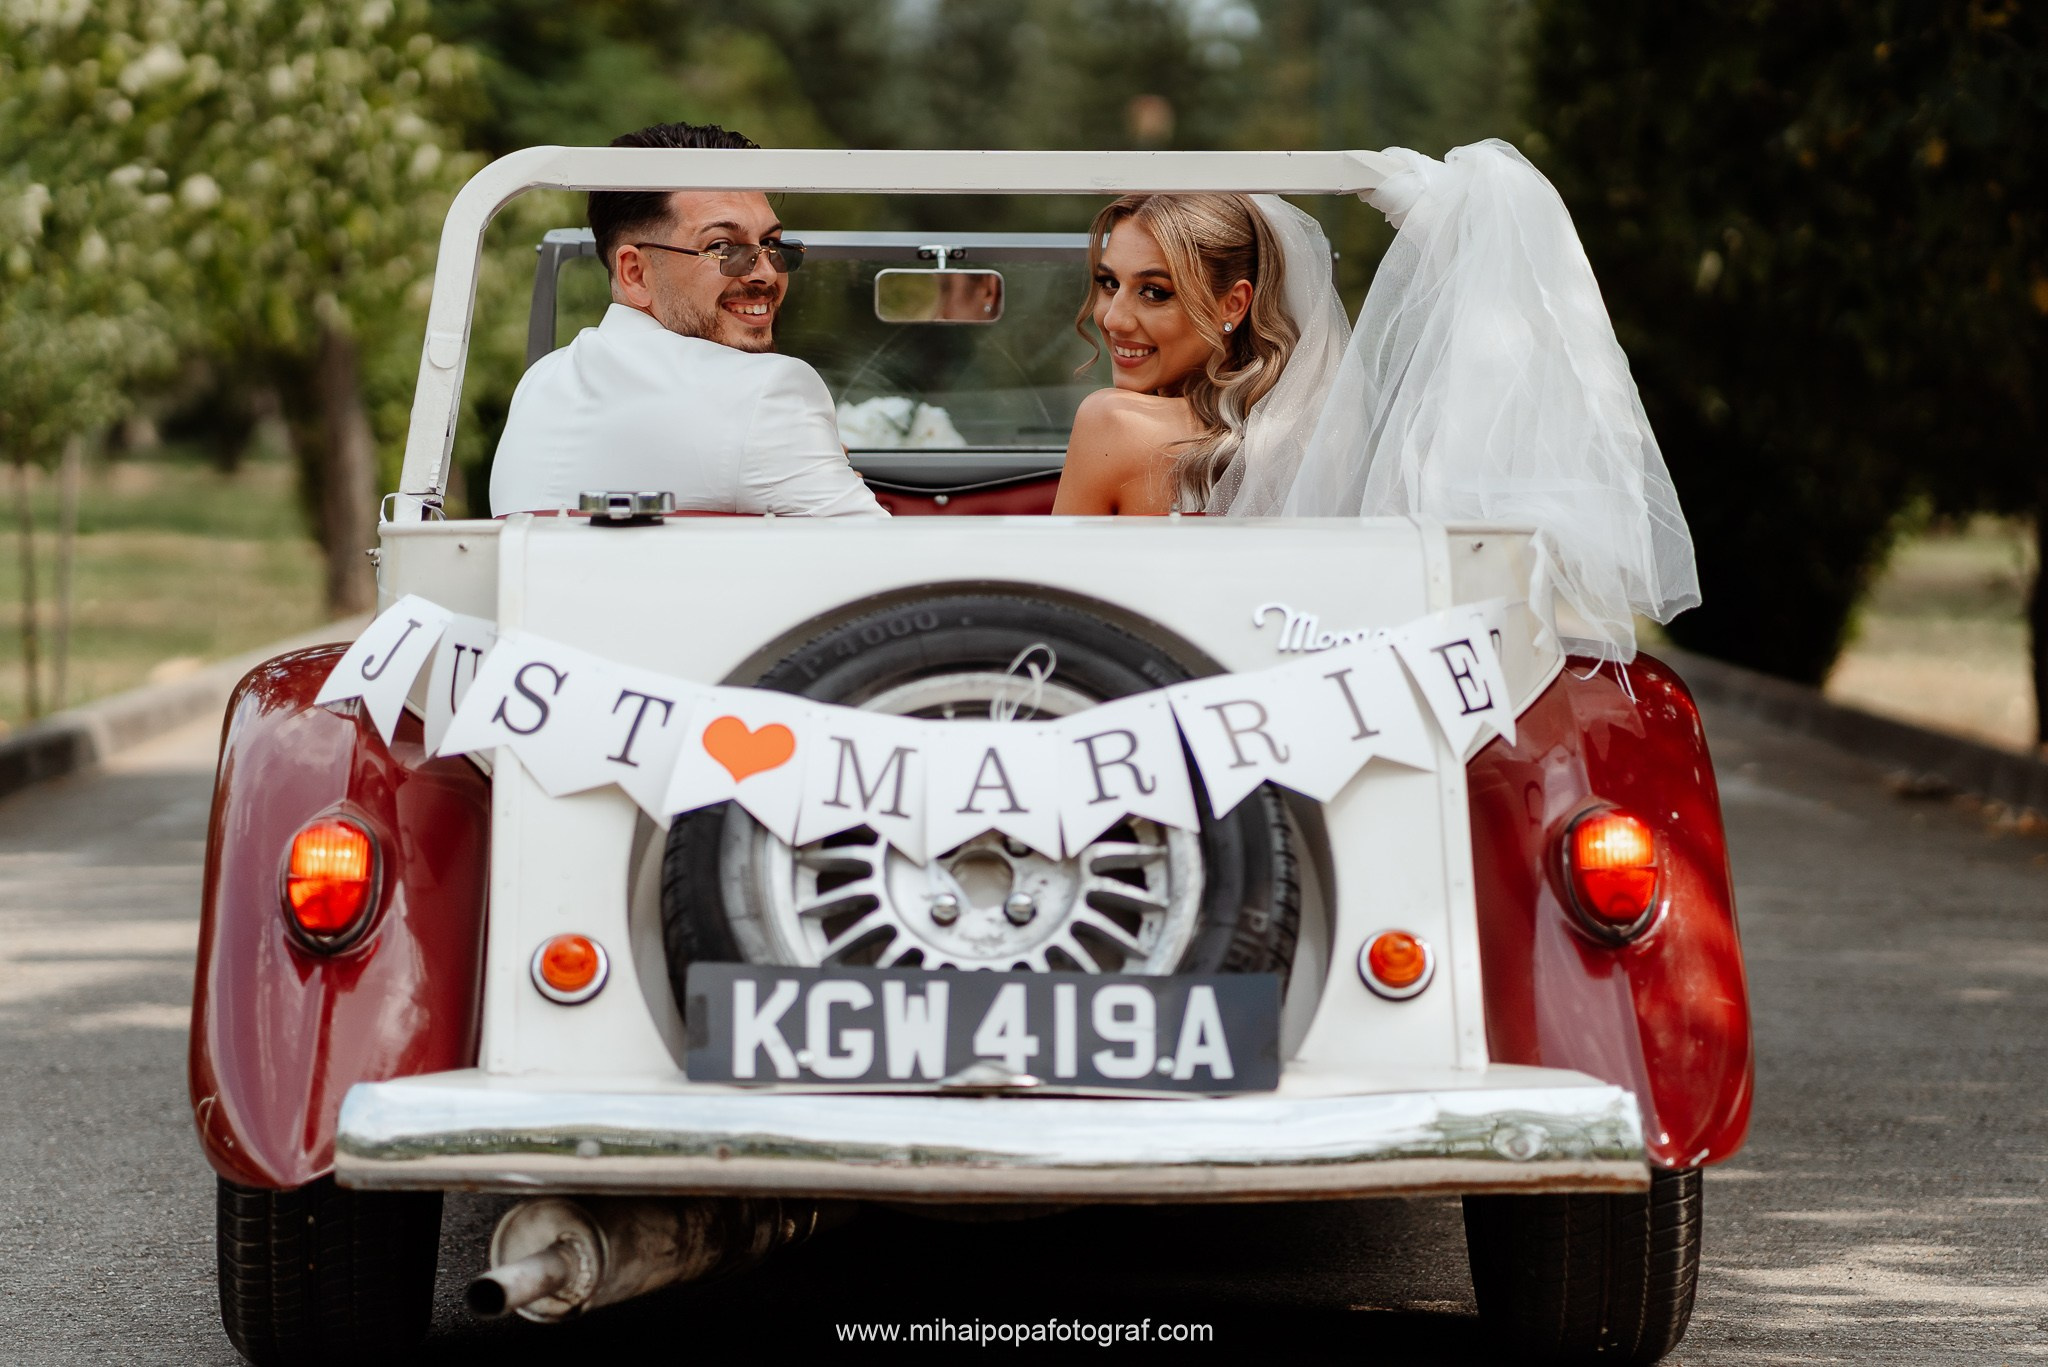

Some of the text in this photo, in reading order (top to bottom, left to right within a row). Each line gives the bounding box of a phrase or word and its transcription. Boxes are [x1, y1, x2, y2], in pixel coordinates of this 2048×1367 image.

[833, 609, 940, 657] 4000
[820, 627, 1502, 819] MARRIE
[731, 979, 951, 1080] KGW
